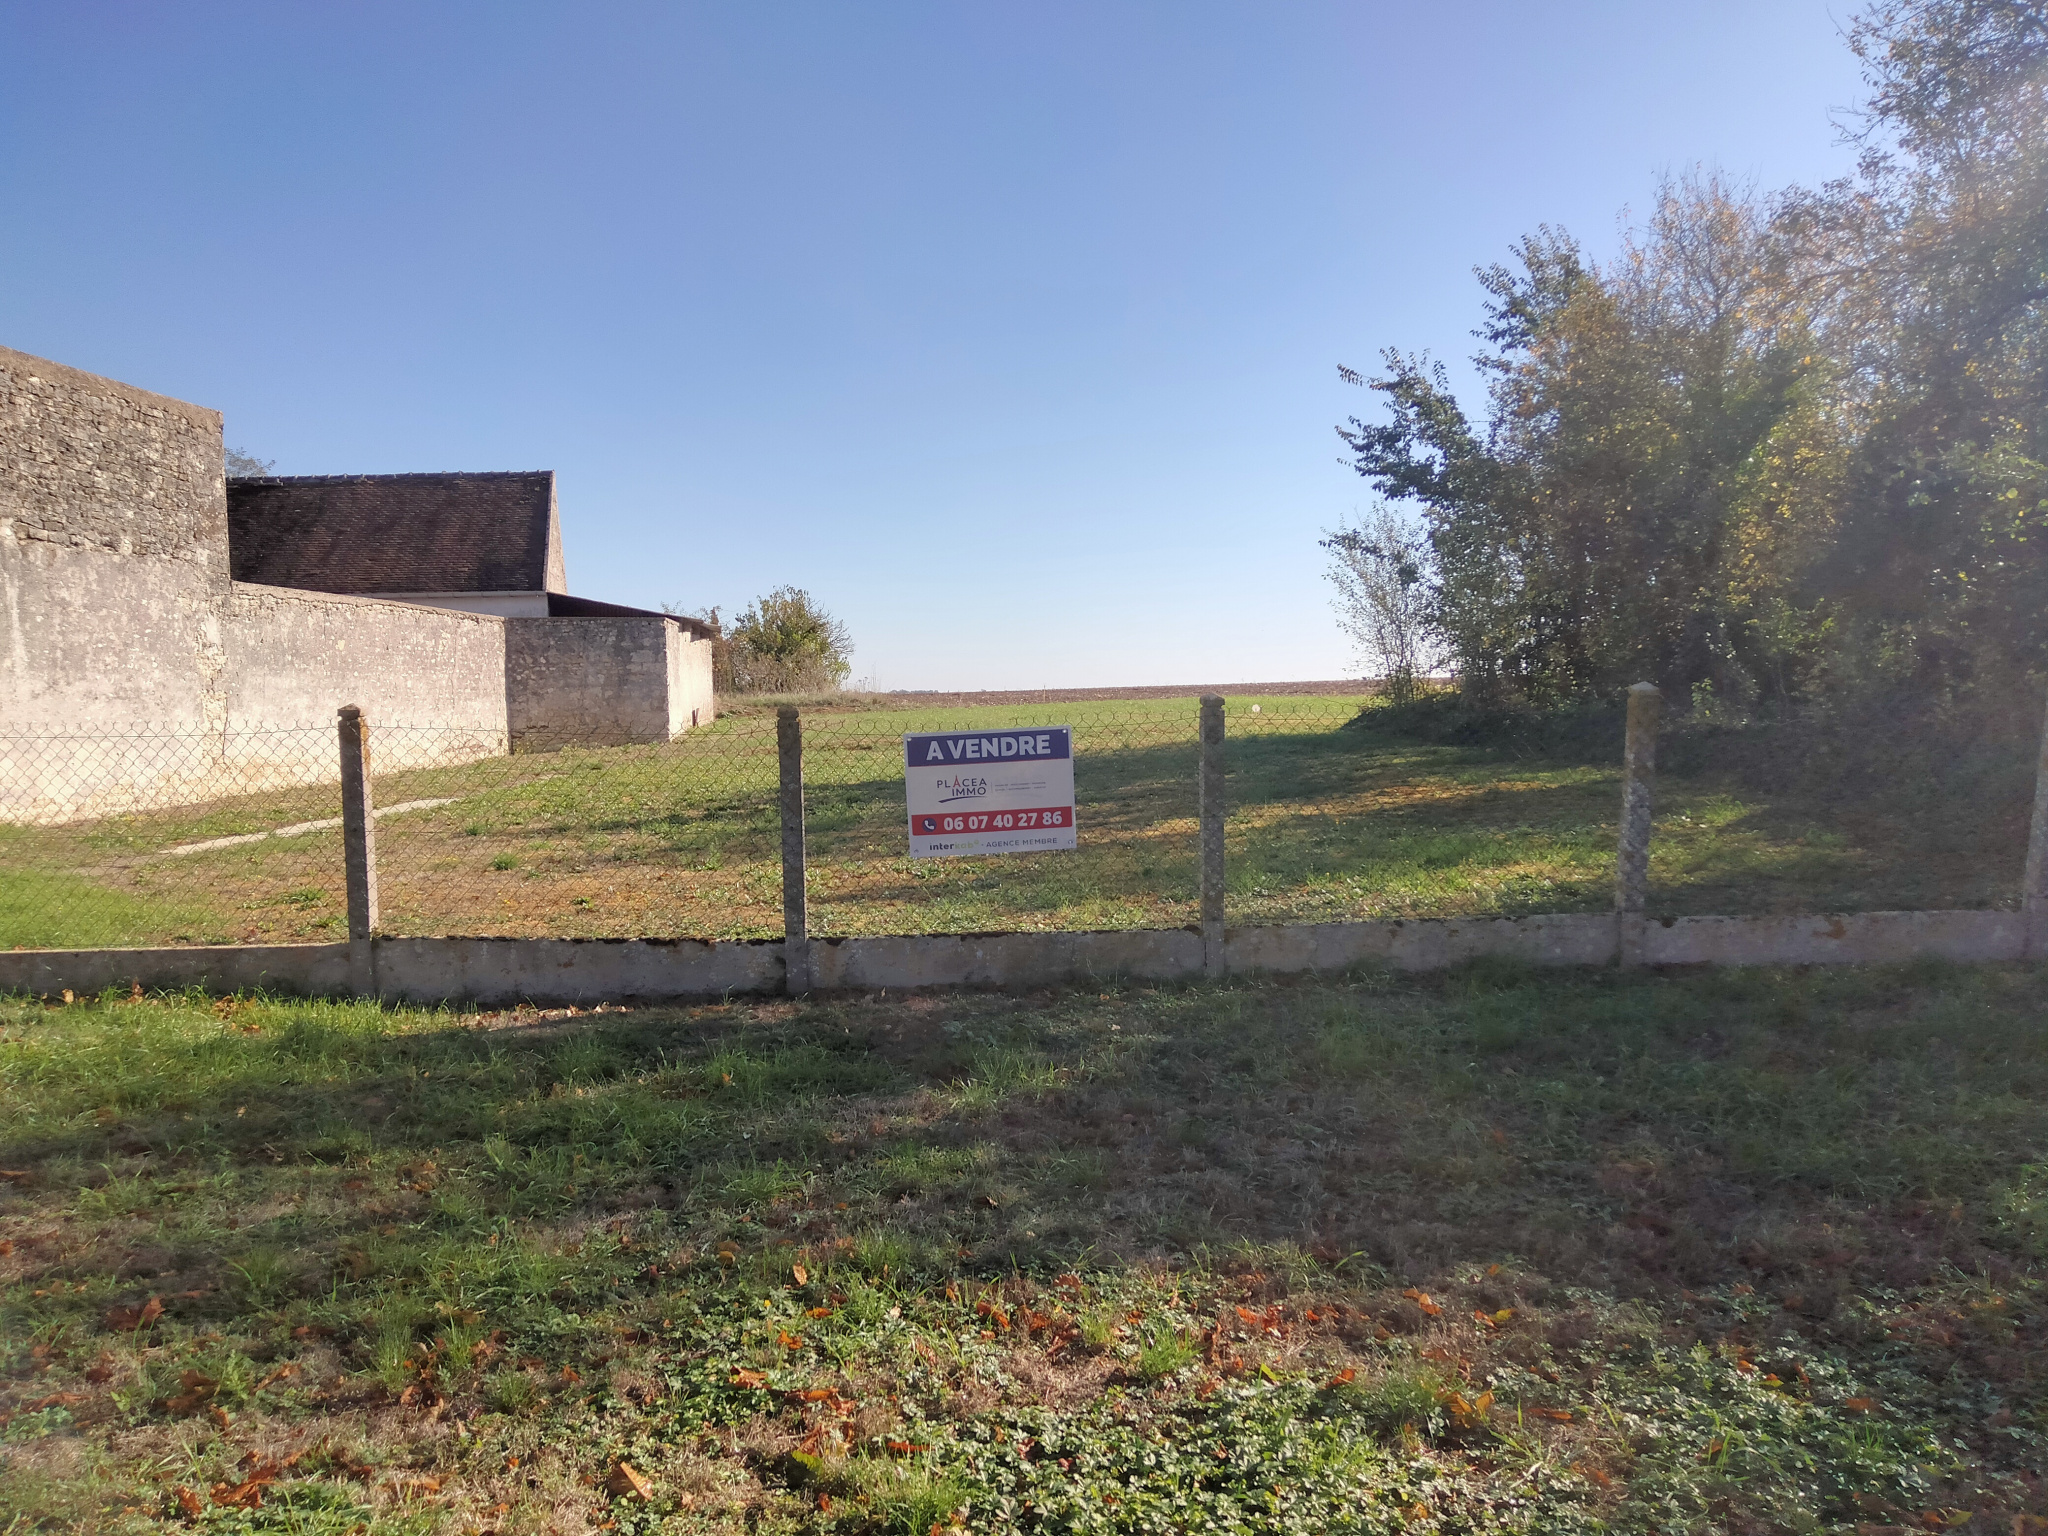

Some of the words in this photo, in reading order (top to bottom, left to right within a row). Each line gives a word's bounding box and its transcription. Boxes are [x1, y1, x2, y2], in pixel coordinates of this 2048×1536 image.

[926, 740, 944, 761] A
[946, 734, 1051, 760] VENDRE
[936, 775, 987, 789] PLACEA
[951, 786, 987, 797] IMMO
[943, 816, 964, 831] 06
[968, 815, 989, 830] 07
[992, 813, 1013, 828] 40
[1017, 812, 1038, 827] 27
[1042, 810, 1063, 825] 86
[985, 839, 1020, 848] AGENCE
[1022, 837, 1058, 846] MEMBRE
